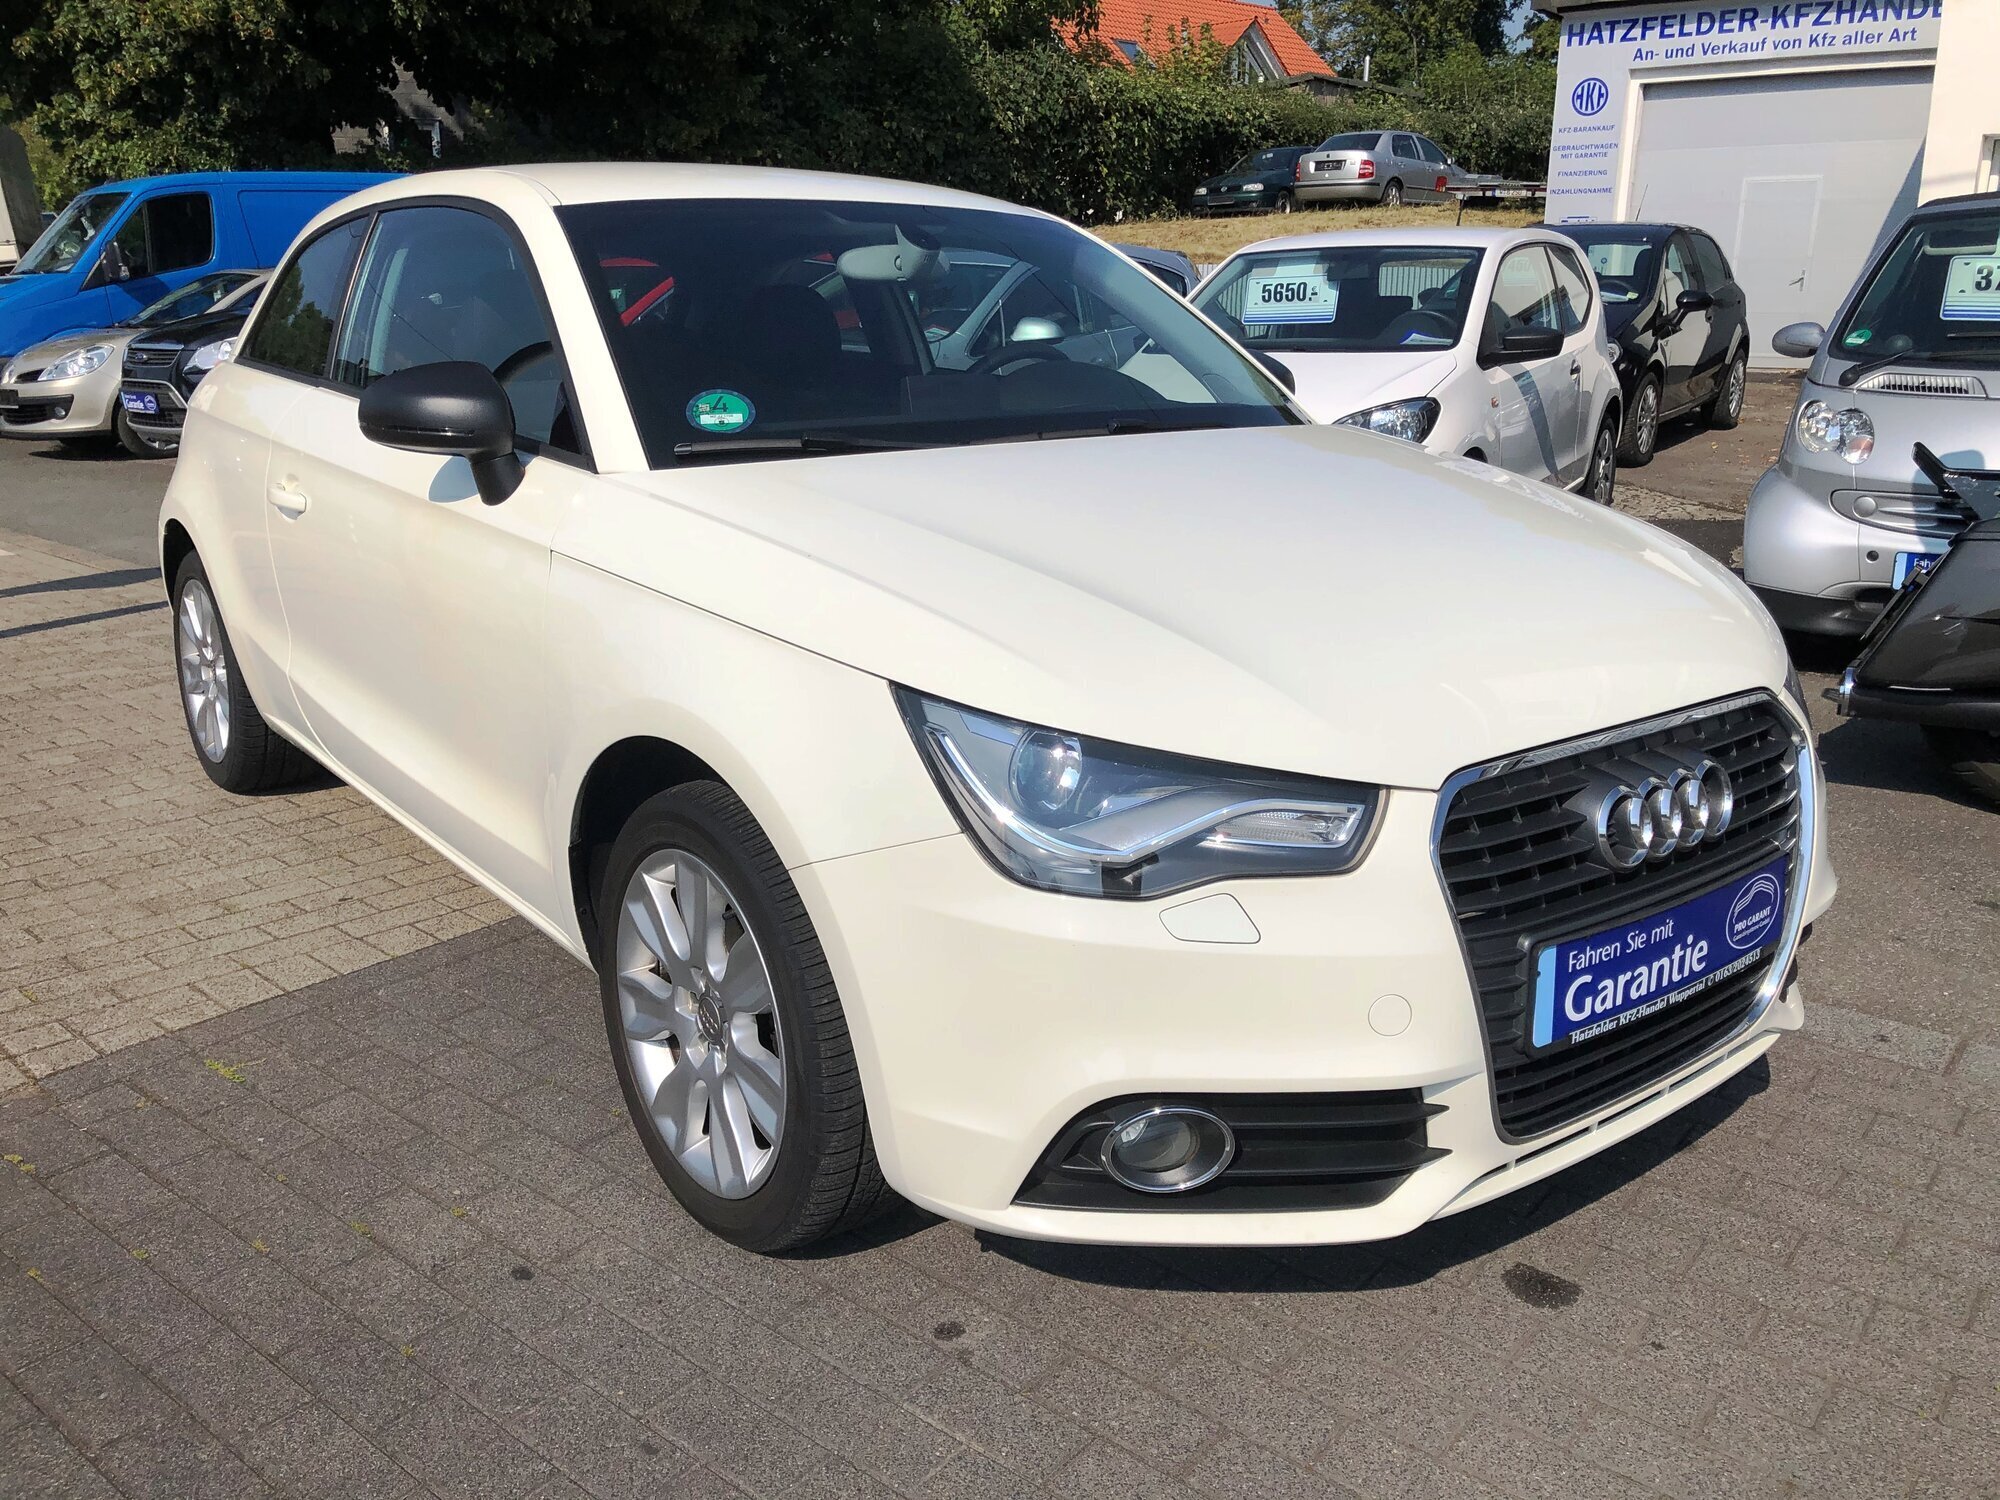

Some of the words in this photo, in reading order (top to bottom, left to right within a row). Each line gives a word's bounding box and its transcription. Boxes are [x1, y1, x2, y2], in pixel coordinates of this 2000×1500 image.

[1633, 47, 1660, 62] An-
[1665, 44, 1696, 59] und
[1700, 37, 1767, 57] Verkauf
[1773, 38, 1802, 51] von
[1808, 33, 1836, 48] Kfz
[1842, 30, 1884, 46] aller
[1888, 27, 1918, 43] Art
[1558, 124, 1616, 134] KFZ-BARANKAUF
[1552, 142, 1619, 152] GEBRAUCHTWAGEN
[1560, 152, 1573, 160] MIT
[1574, 151, 1609, 160] GARANTIE
[1557, 169, 1608, 178] FINANZIERUNG
[1549, 187, 1613, 195] INZAHLUNGNAHME
[1975, 265, 2000, 291] 3
[1733, 920, 1747, 934] PRO
[1747, 905, 1772, 926] GARANT
[1568, 942, 1620, 973] Fahren
[1626, 930, 1647, 953] Sie
[1651, 919, 1674, 944] mit
[1564, 934, 1709, 1022] Garantie
[1570, 1019, 1618, 1045] Hatzfelder
[1619, 998, 1667, 1026] KFZ-Handel
[1669, 980, 1705, 1005] Wuppertal
